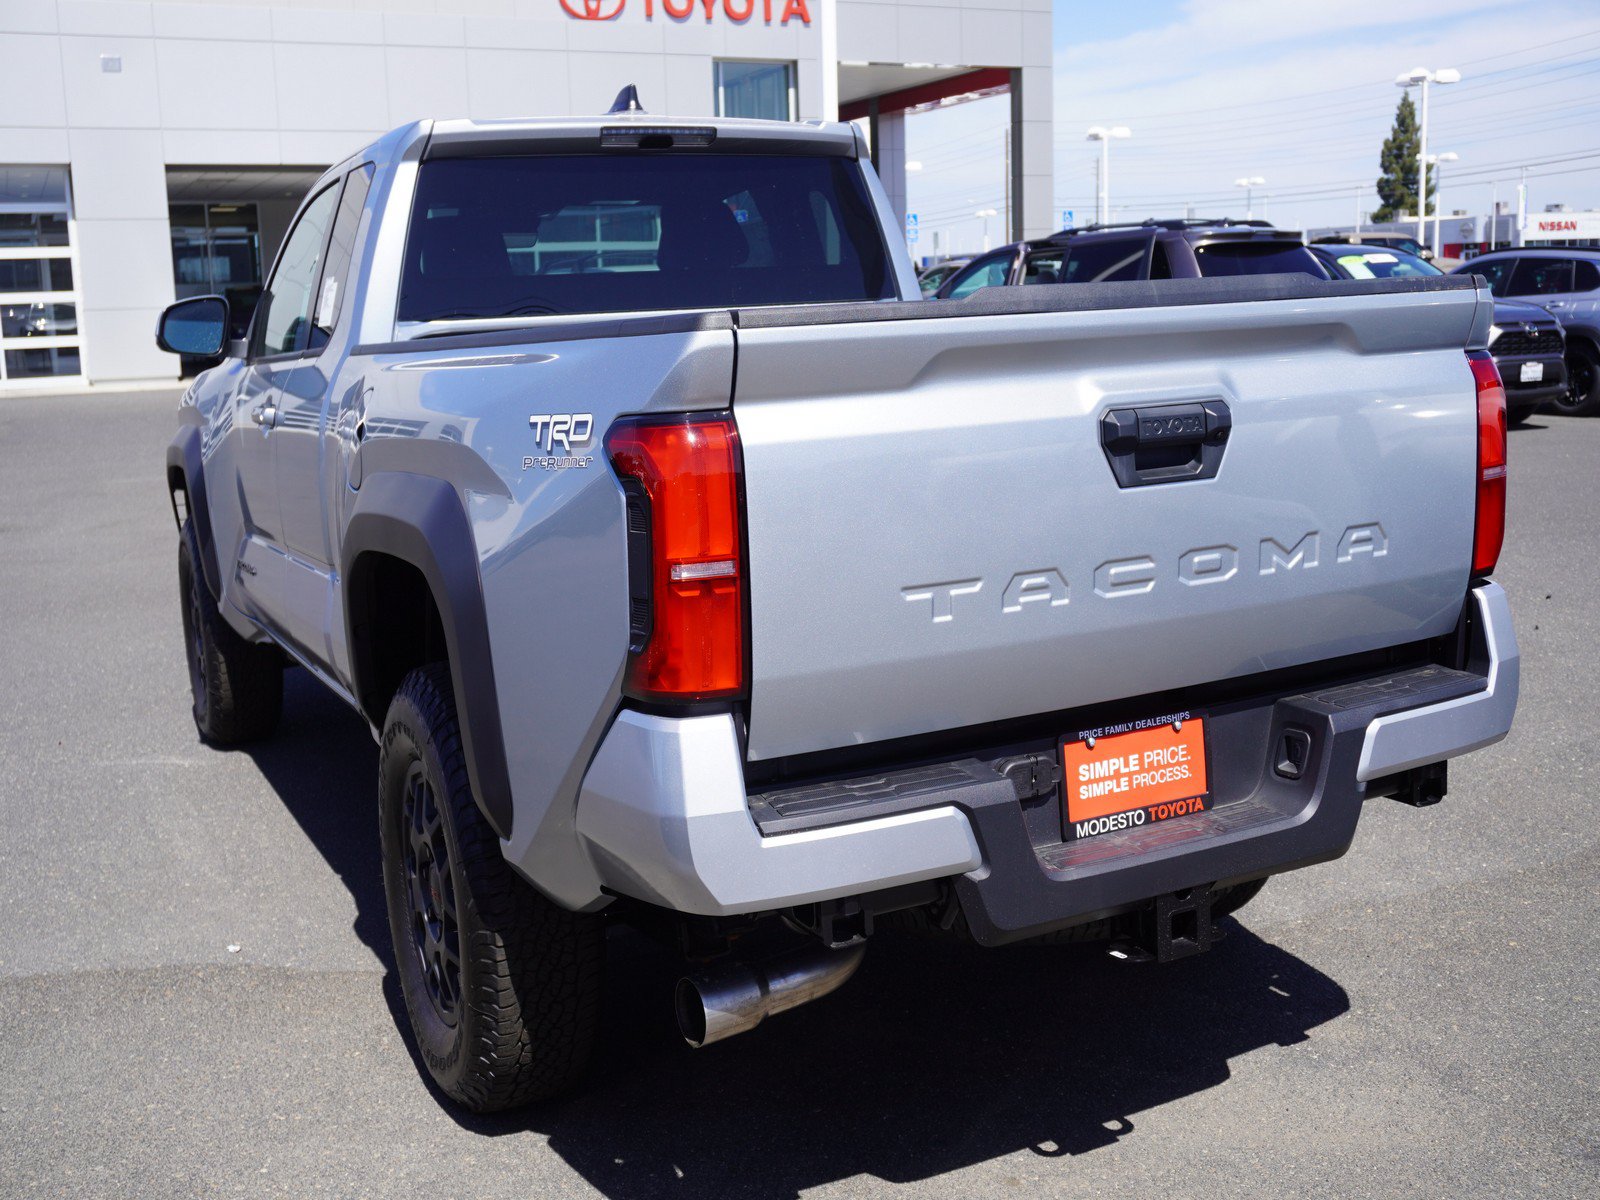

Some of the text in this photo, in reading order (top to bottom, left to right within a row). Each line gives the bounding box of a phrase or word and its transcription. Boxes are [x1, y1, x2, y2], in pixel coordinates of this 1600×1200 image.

[1538, 220, 1578, 231] NISSAN
[529, 413, 593, 451] TRD
[1142, 415, 1203, 436] TOYOTA
[901, 522, 1388, 622] TACOMA
[1079, 711, 1190, 740] PRICE FAMILY DEALERSHIPS
[1078, 744, 1191, 781] SIMPLE PRICE.
[1079, 765, 1192, 800] SIMPLE PROCESS.
[1076, 797, 1204, 839] MODESTO TOYOTA
